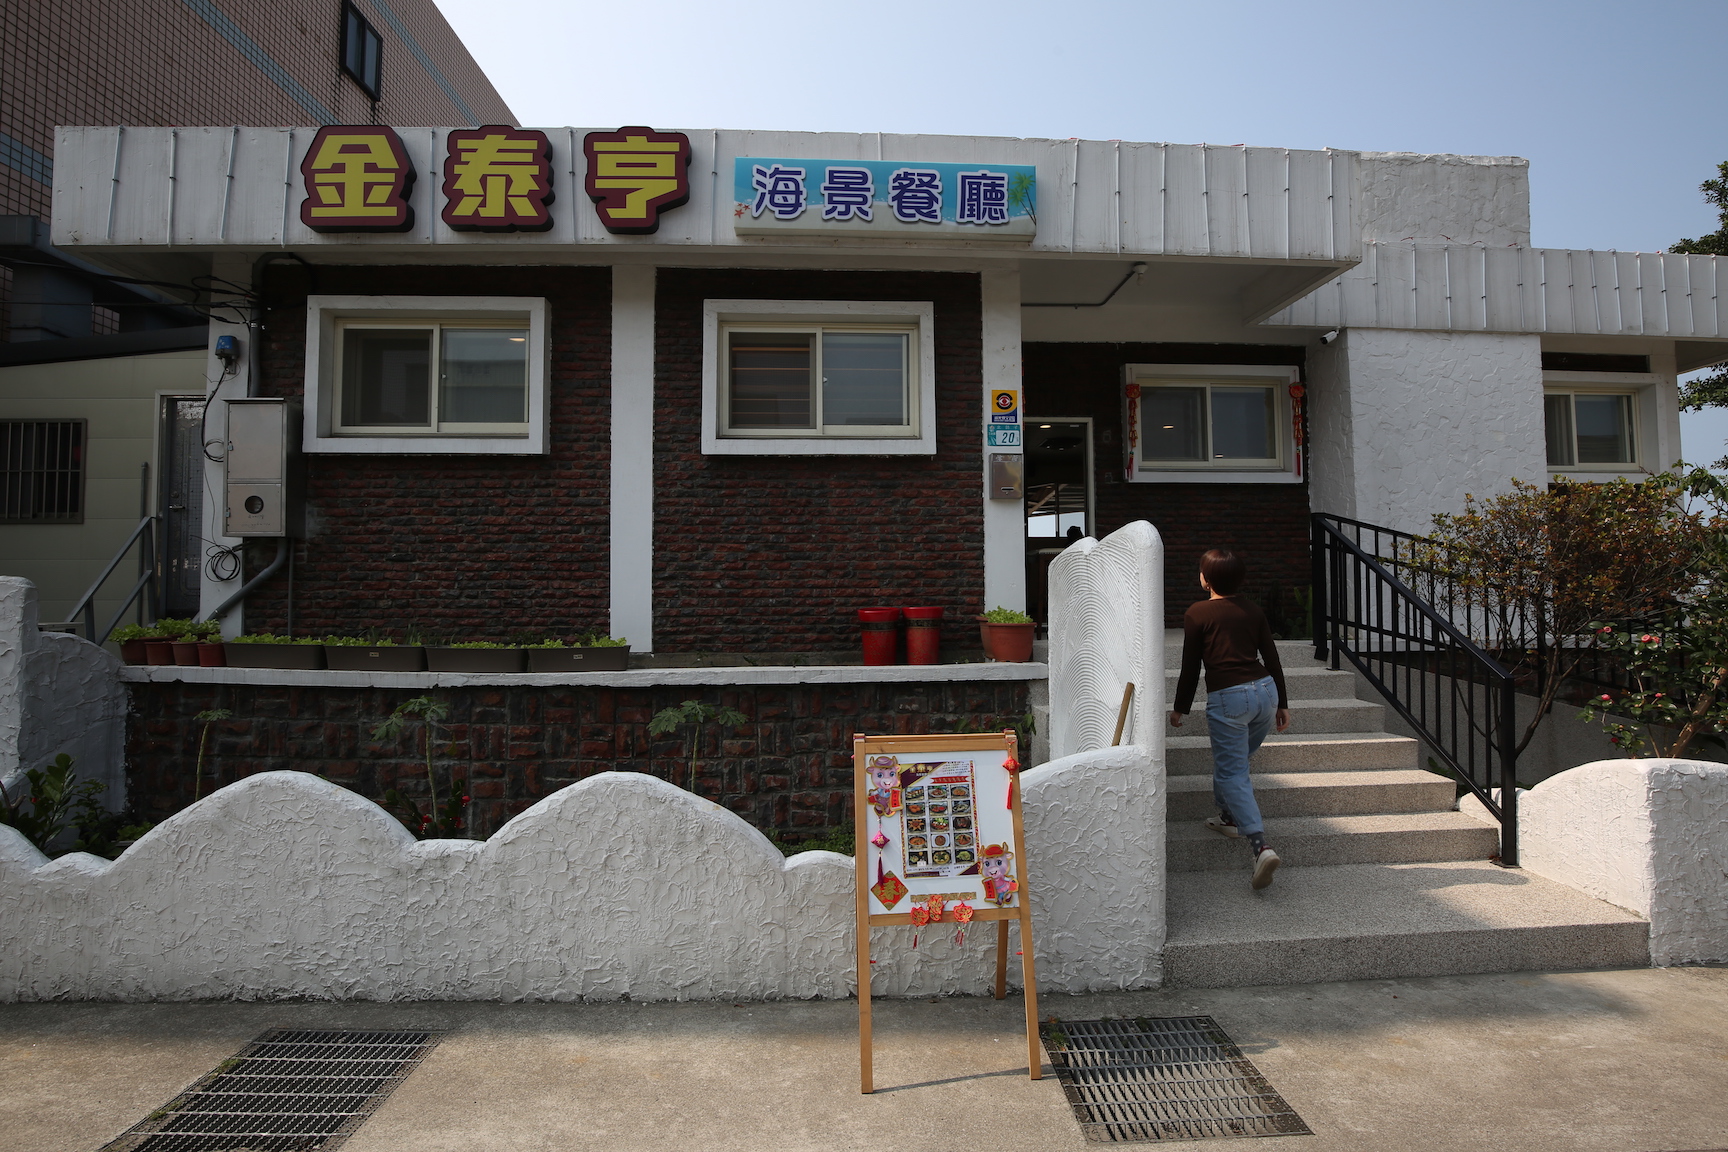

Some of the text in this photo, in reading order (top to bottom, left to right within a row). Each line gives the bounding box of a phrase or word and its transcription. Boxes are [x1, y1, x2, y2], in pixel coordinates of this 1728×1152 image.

[310, 134, 681, 219] 金泰亨
[754, 166, 1007, 222] 海景餐廳
[1002, 432, 1015, 443] 20
[883, 880, 900, 900] 春
